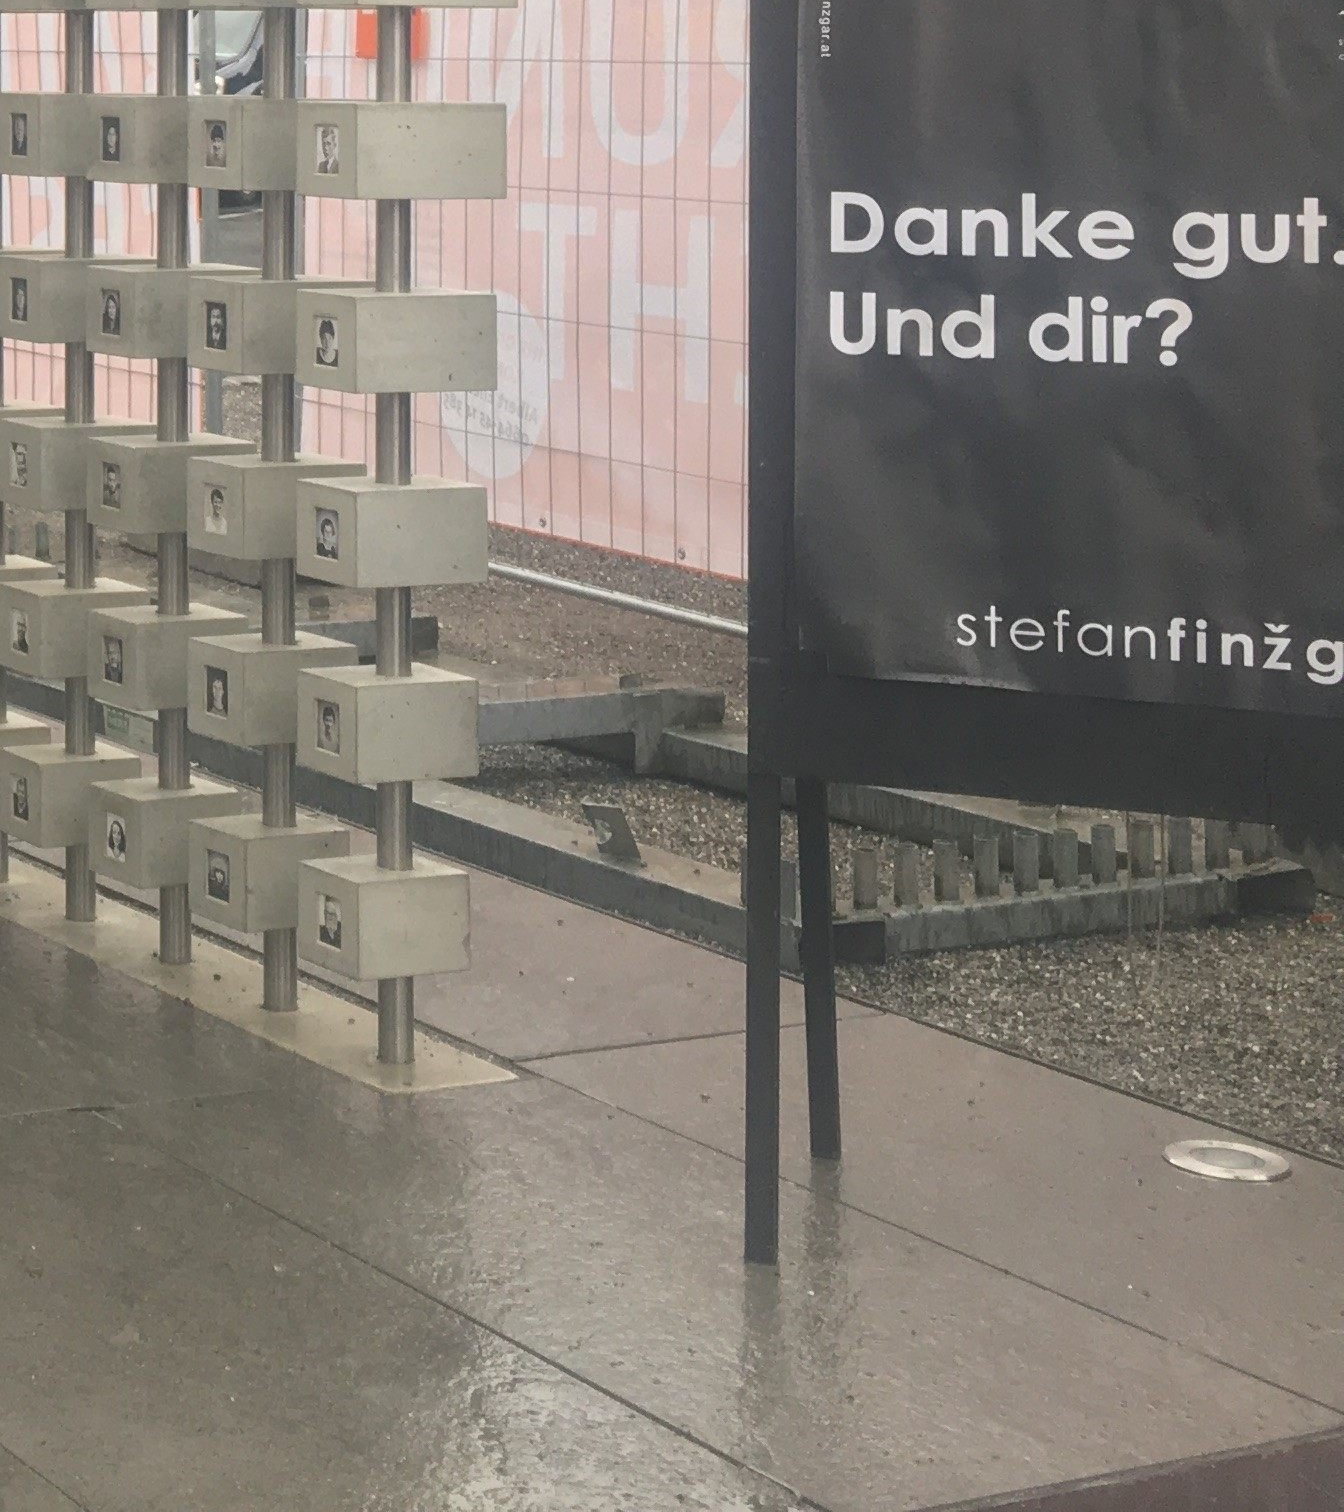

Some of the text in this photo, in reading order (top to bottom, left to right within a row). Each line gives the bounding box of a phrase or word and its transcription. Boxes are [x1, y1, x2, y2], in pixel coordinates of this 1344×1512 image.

[830, 191, 1344, 279] Danke gut.
[829, 291, 1193, 366] Und dir?
